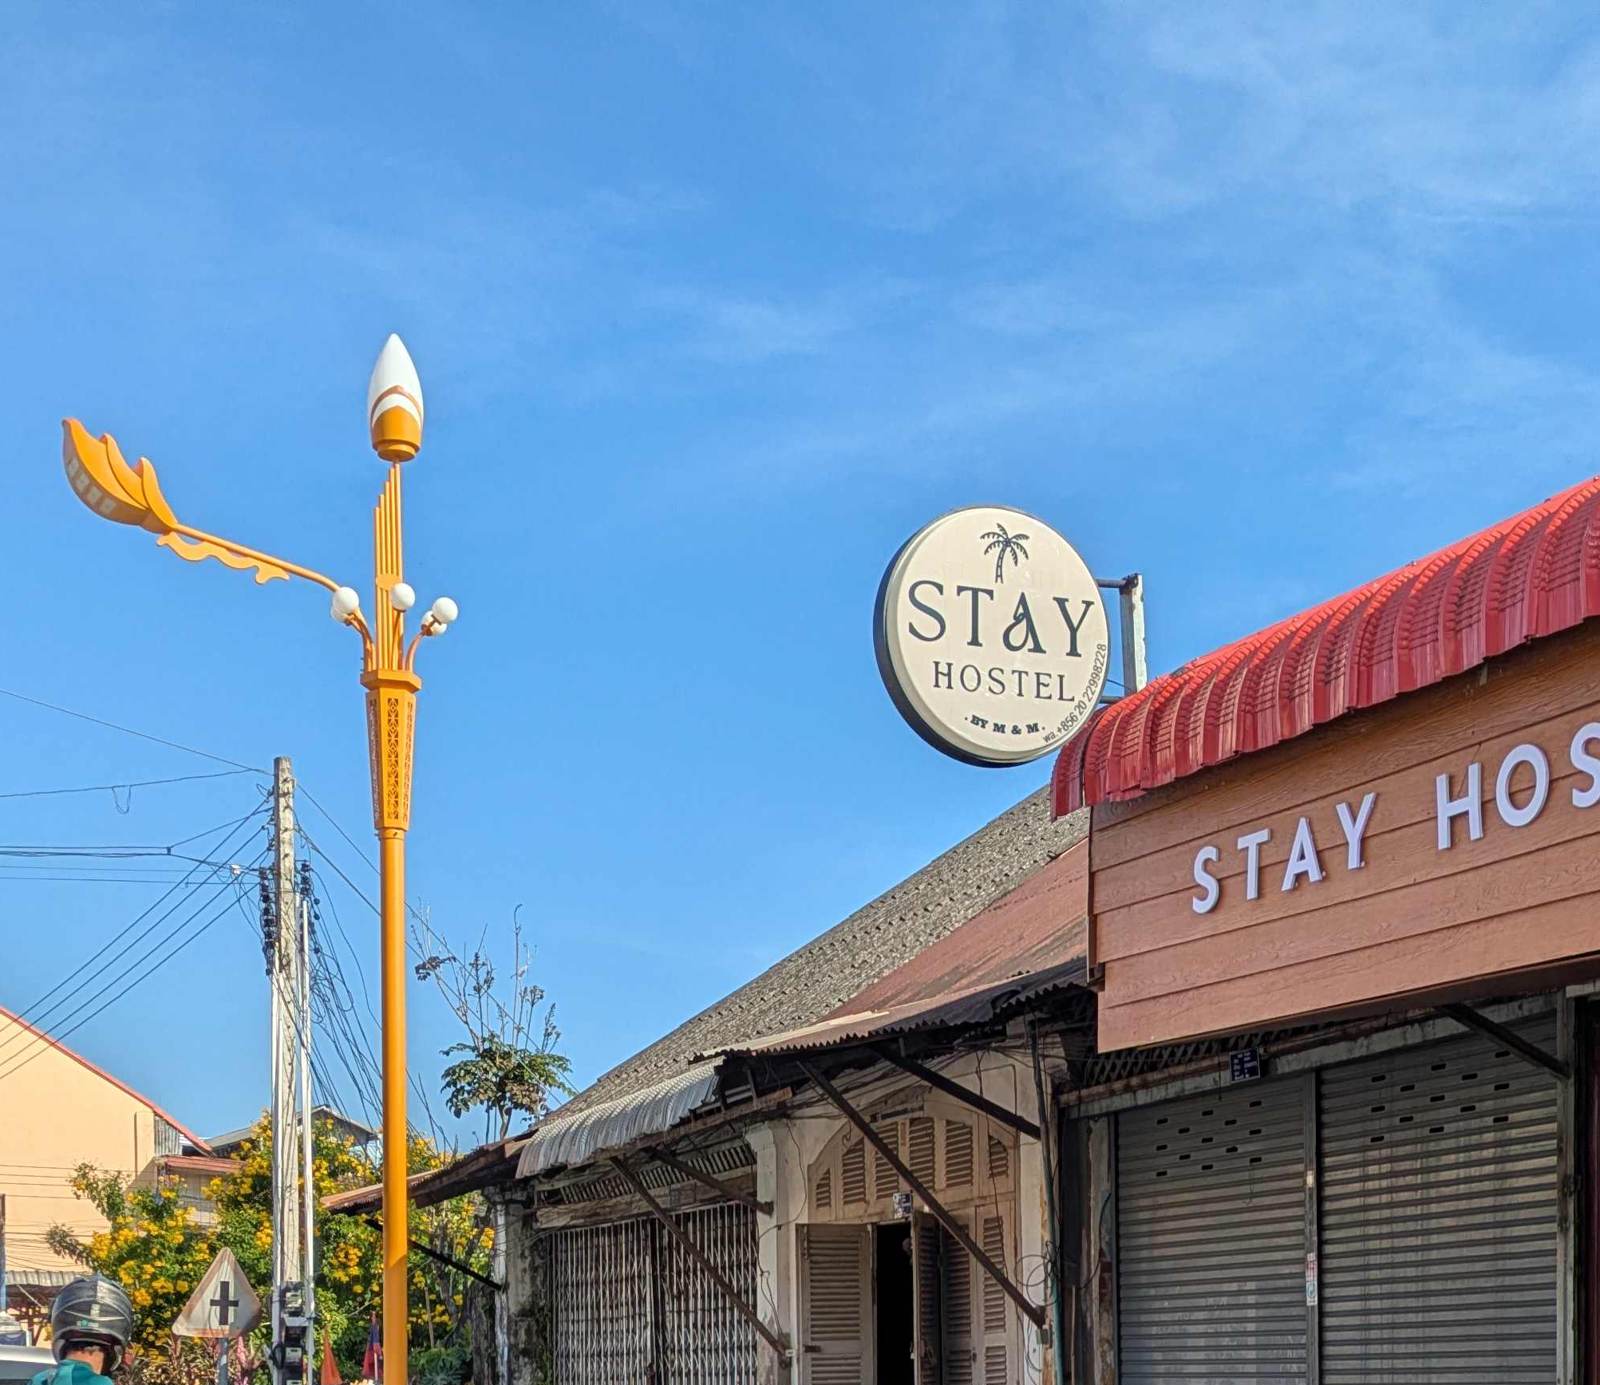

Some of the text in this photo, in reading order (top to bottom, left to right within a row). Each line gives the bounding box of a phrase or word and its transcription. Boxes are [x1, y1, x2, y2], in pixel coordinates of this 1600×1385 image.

[908, 580, 1095, 658] STAY
[932, 660, 1075, 702] HOSTEL
[1057, 712, 1079, 734] +856
[1074, 700, 1088, 716] 20
[1082, 643, 1107, 702] 22998228
[970, 715, 1040, 735] BY M & M
[1192, 722, 1600, 915] STAY HOS
